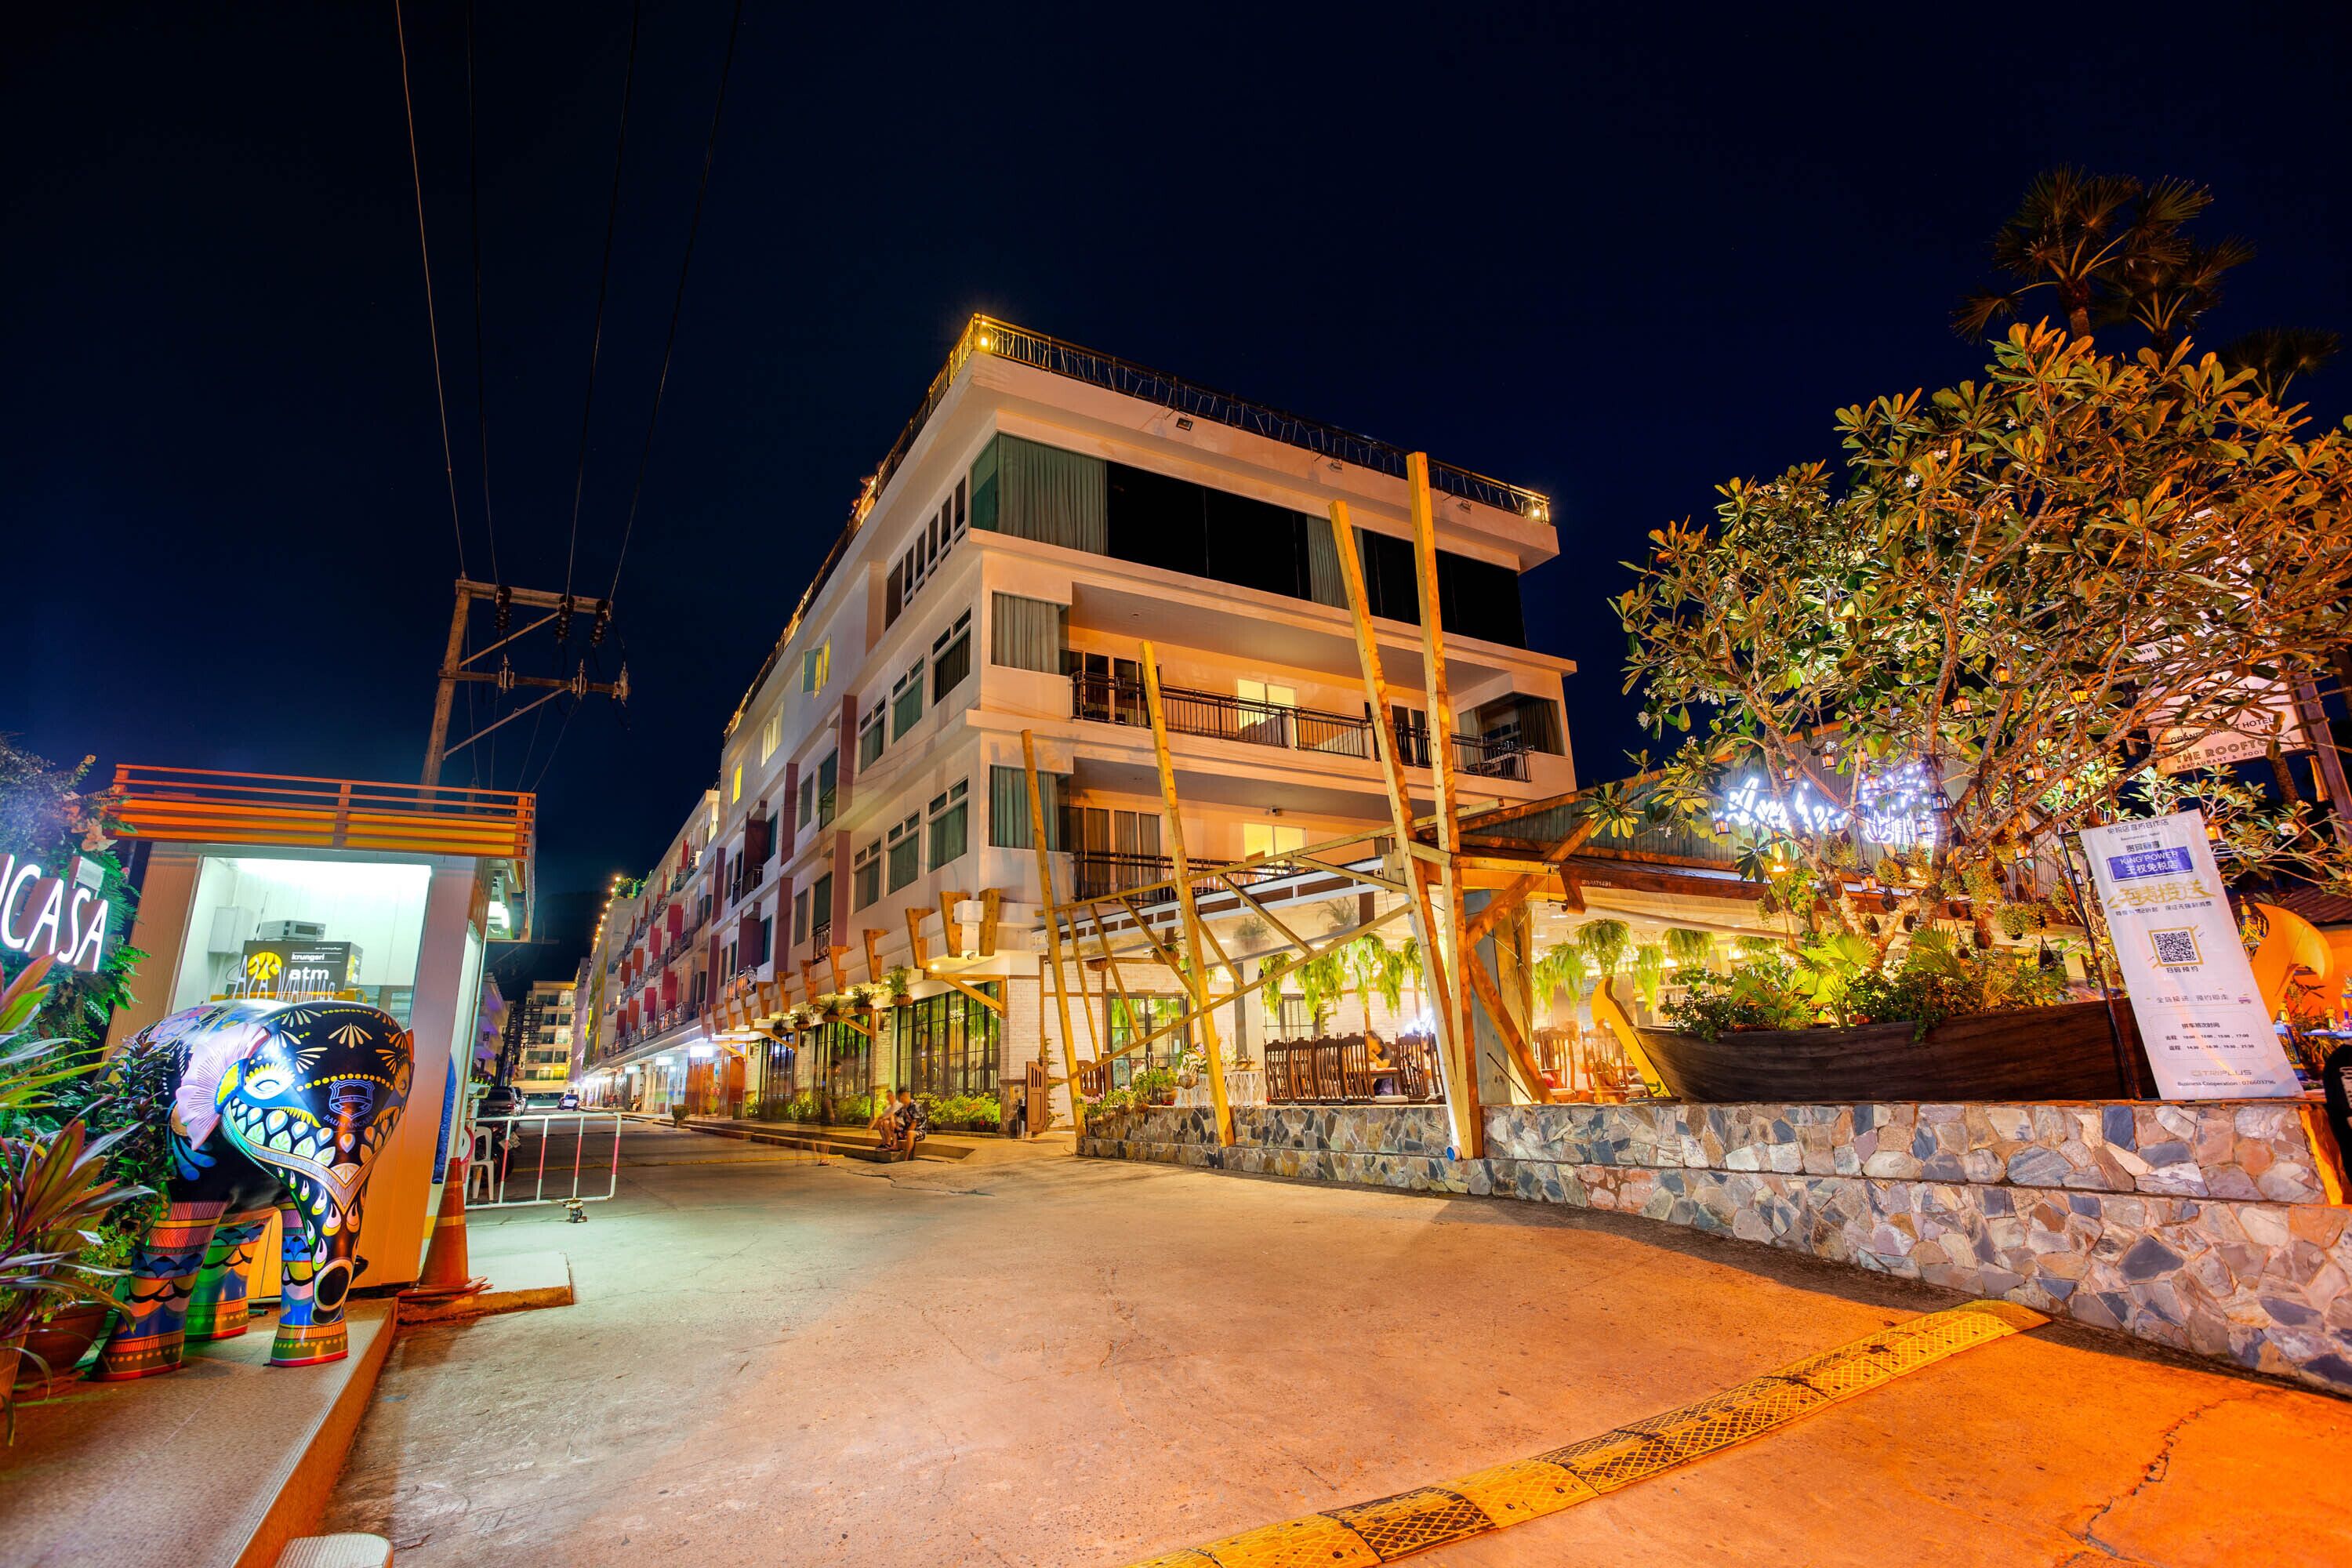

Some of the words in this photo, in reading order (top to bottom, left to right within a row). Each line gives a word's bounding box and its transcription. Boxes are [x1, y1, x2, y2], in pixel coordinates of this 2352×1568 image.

[2242, 716, 2274, 728] HOTEL
[2174, 751, 2201, 764] THE
[2205, 738, 2276, 758] ROOFTO
[2176, 757, 2227, 770] RESTAURANT
[2120, 855, 2142, 865] KING
[2145, 851, 2178, 860] POWER
[2127, 859, 2178, 875] 王权免税店
[289, 967, 329, 980] atm
